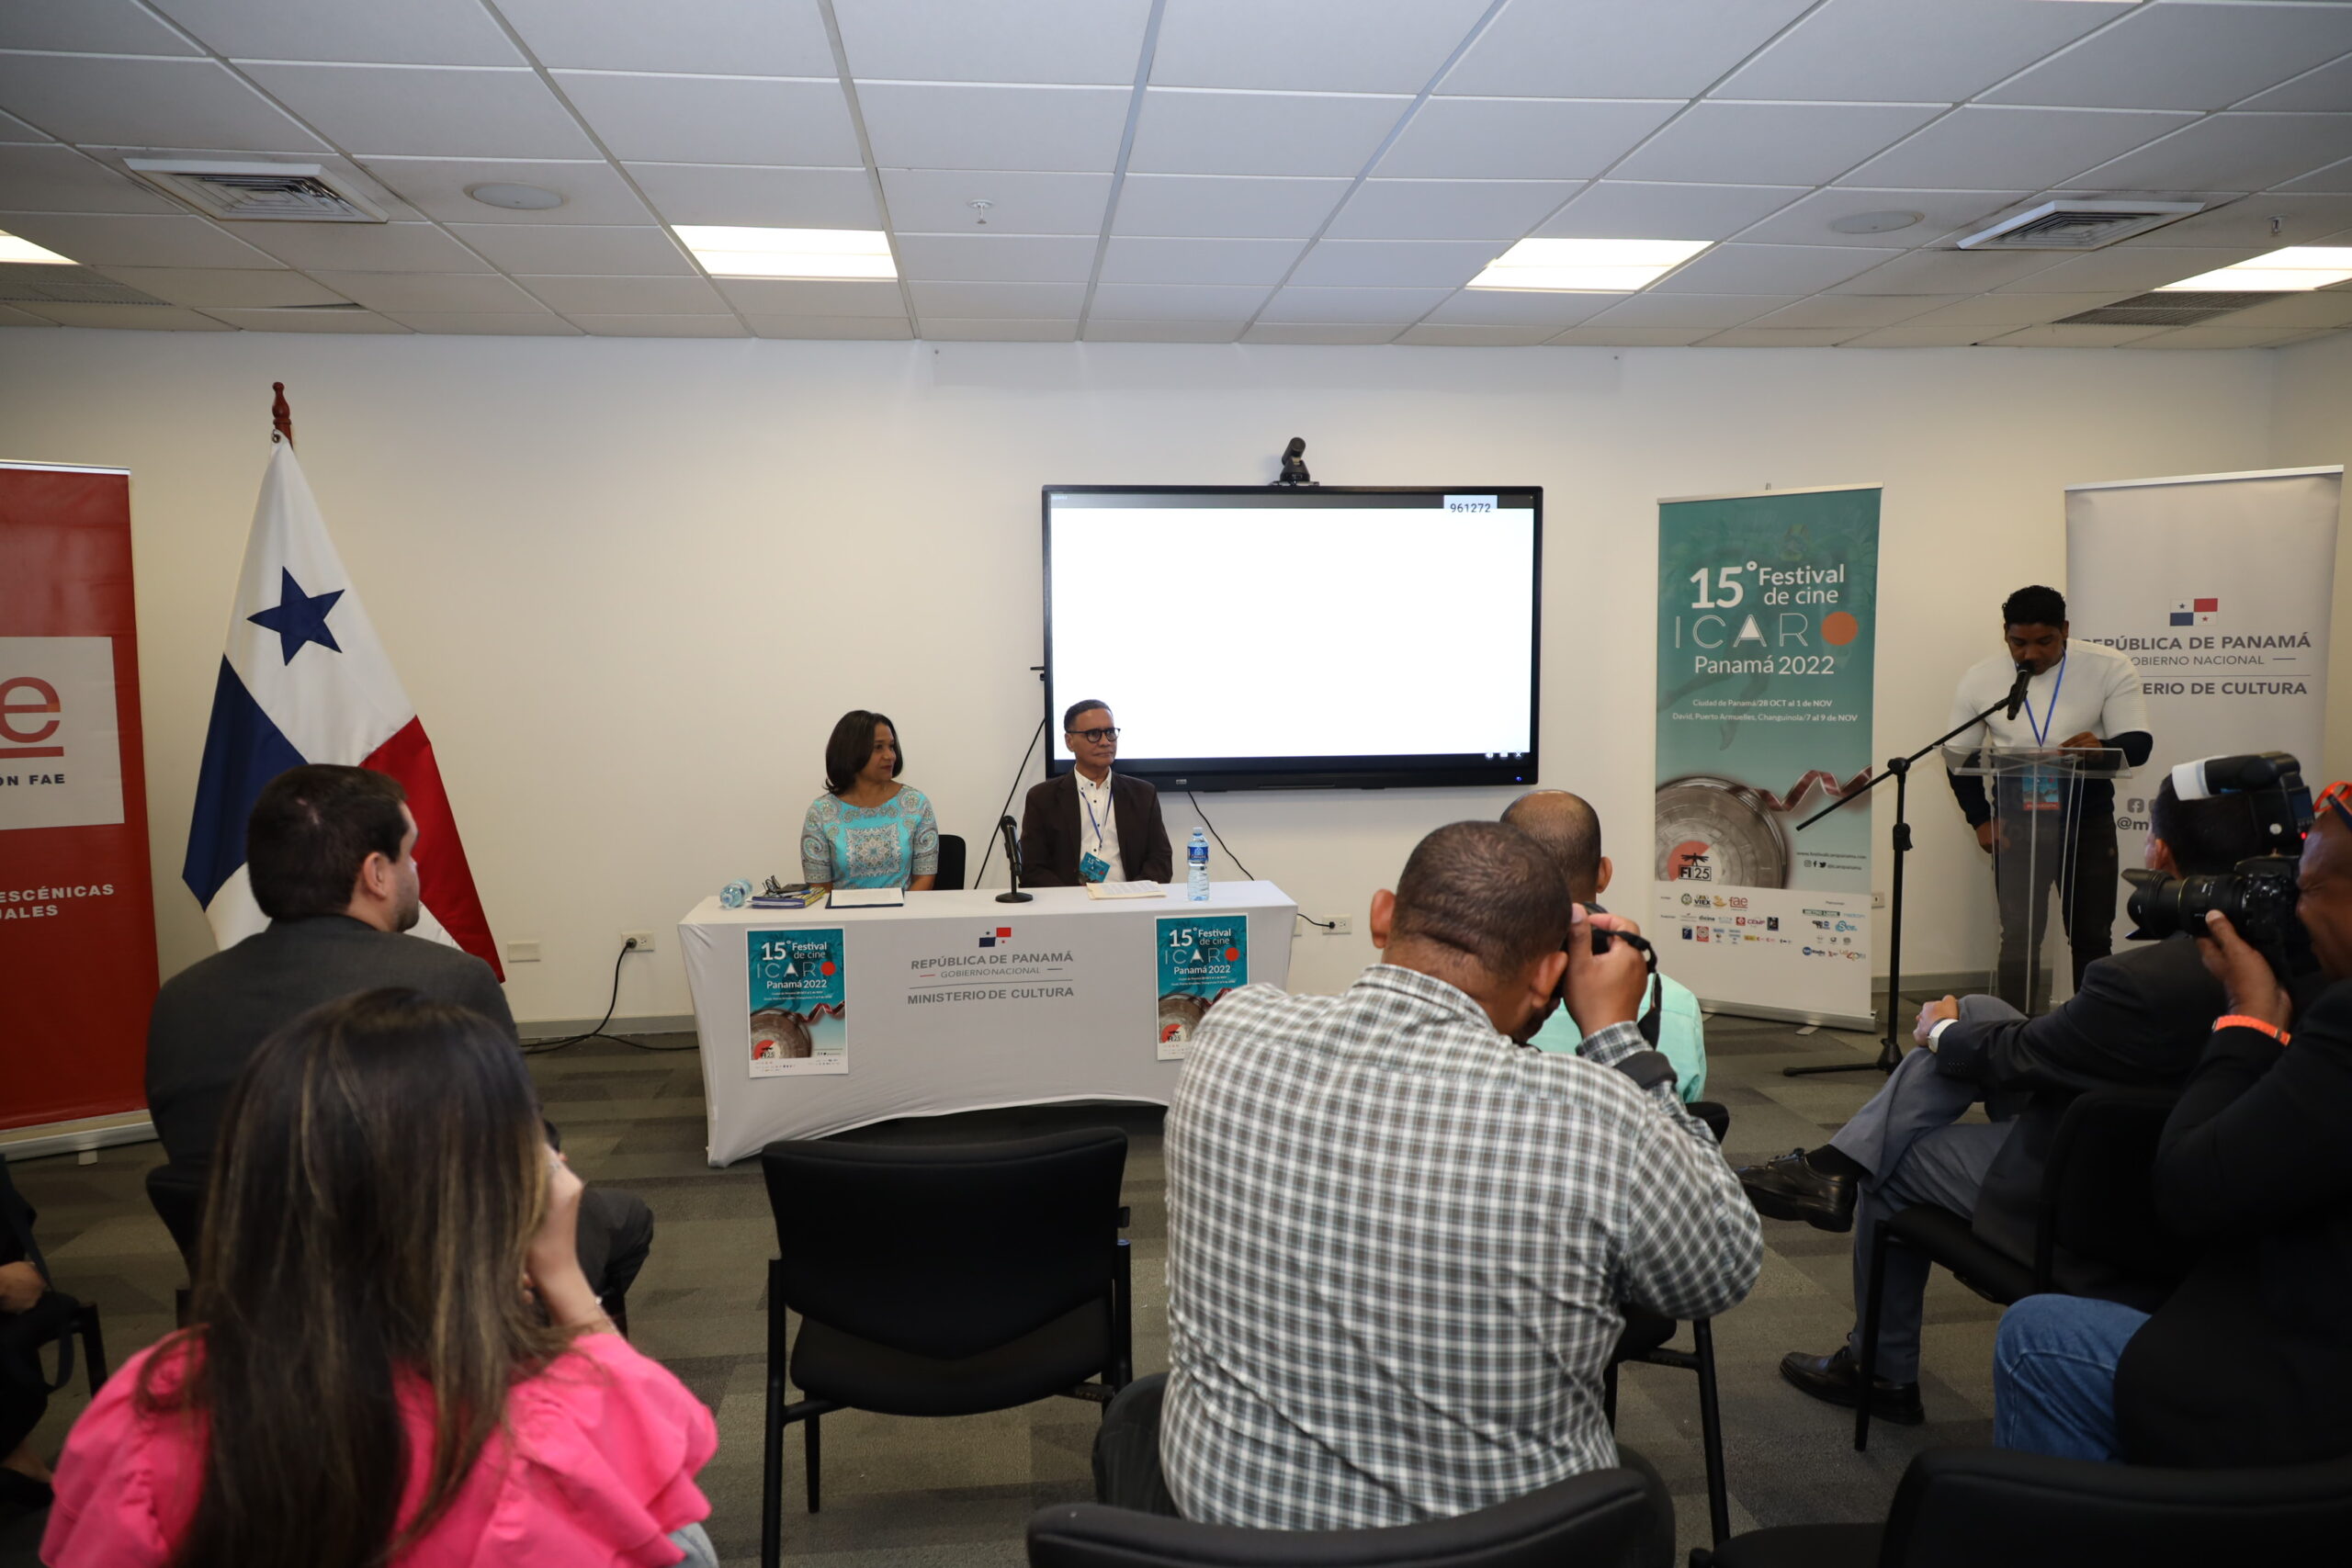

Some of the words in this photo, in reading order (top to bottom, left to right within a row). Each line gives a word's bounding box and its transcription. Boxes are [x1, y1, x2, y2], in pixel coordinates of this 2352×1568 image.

[1450, 503, 1491, 513] 961272
[1758, 564, 1845, 586] Festival
[1764, 588, 1789, 605] de
[1795, 587, 1838, 604] cine
[2189, 637, 2215, 649] DE
[2222, 632, 2312, 649] PANAMÁ
[1694, 655, 1773, 673] Panamá
[1779, 656, 1834, 675] 2022
[2131, 656, 2189, 666] OBIERNO
[2193, 656, 2265, 665] NACIONAL
[2191, 682, 2215, 694] DE
[2222, 682, 2308, 694] CULTURA
[1838, 714, 1858, 722] NOV
[28, 773, 65, 785] FAE
[0, 904, 58, 919] ALES
[1198, 929, 1231, 938] Festival
[792, 942, 827, 951] Festival
[808, 951, 826, 959] cine
[910, 954, 987, 970] REPÚBLICA
[989, 954, 1007, 964] DE
[1012, 950, 1073, 964] PANAMÁ
[941, 969, 994, 978] GOBIERNO
[995, 967, 1041, 976] NACIONAL
[1174, 965, 1207, 975] Panamá
[1208, 964, 1231, 974] 2022
[766, 980, 802, 989] Panamá
[803, 979, 827, 988] 2022
[908, 991, 987, 1005] MINISTERIO
[989, 989, 1007, 999] DE
[1011, 987, 1074, 998] CULTURA
